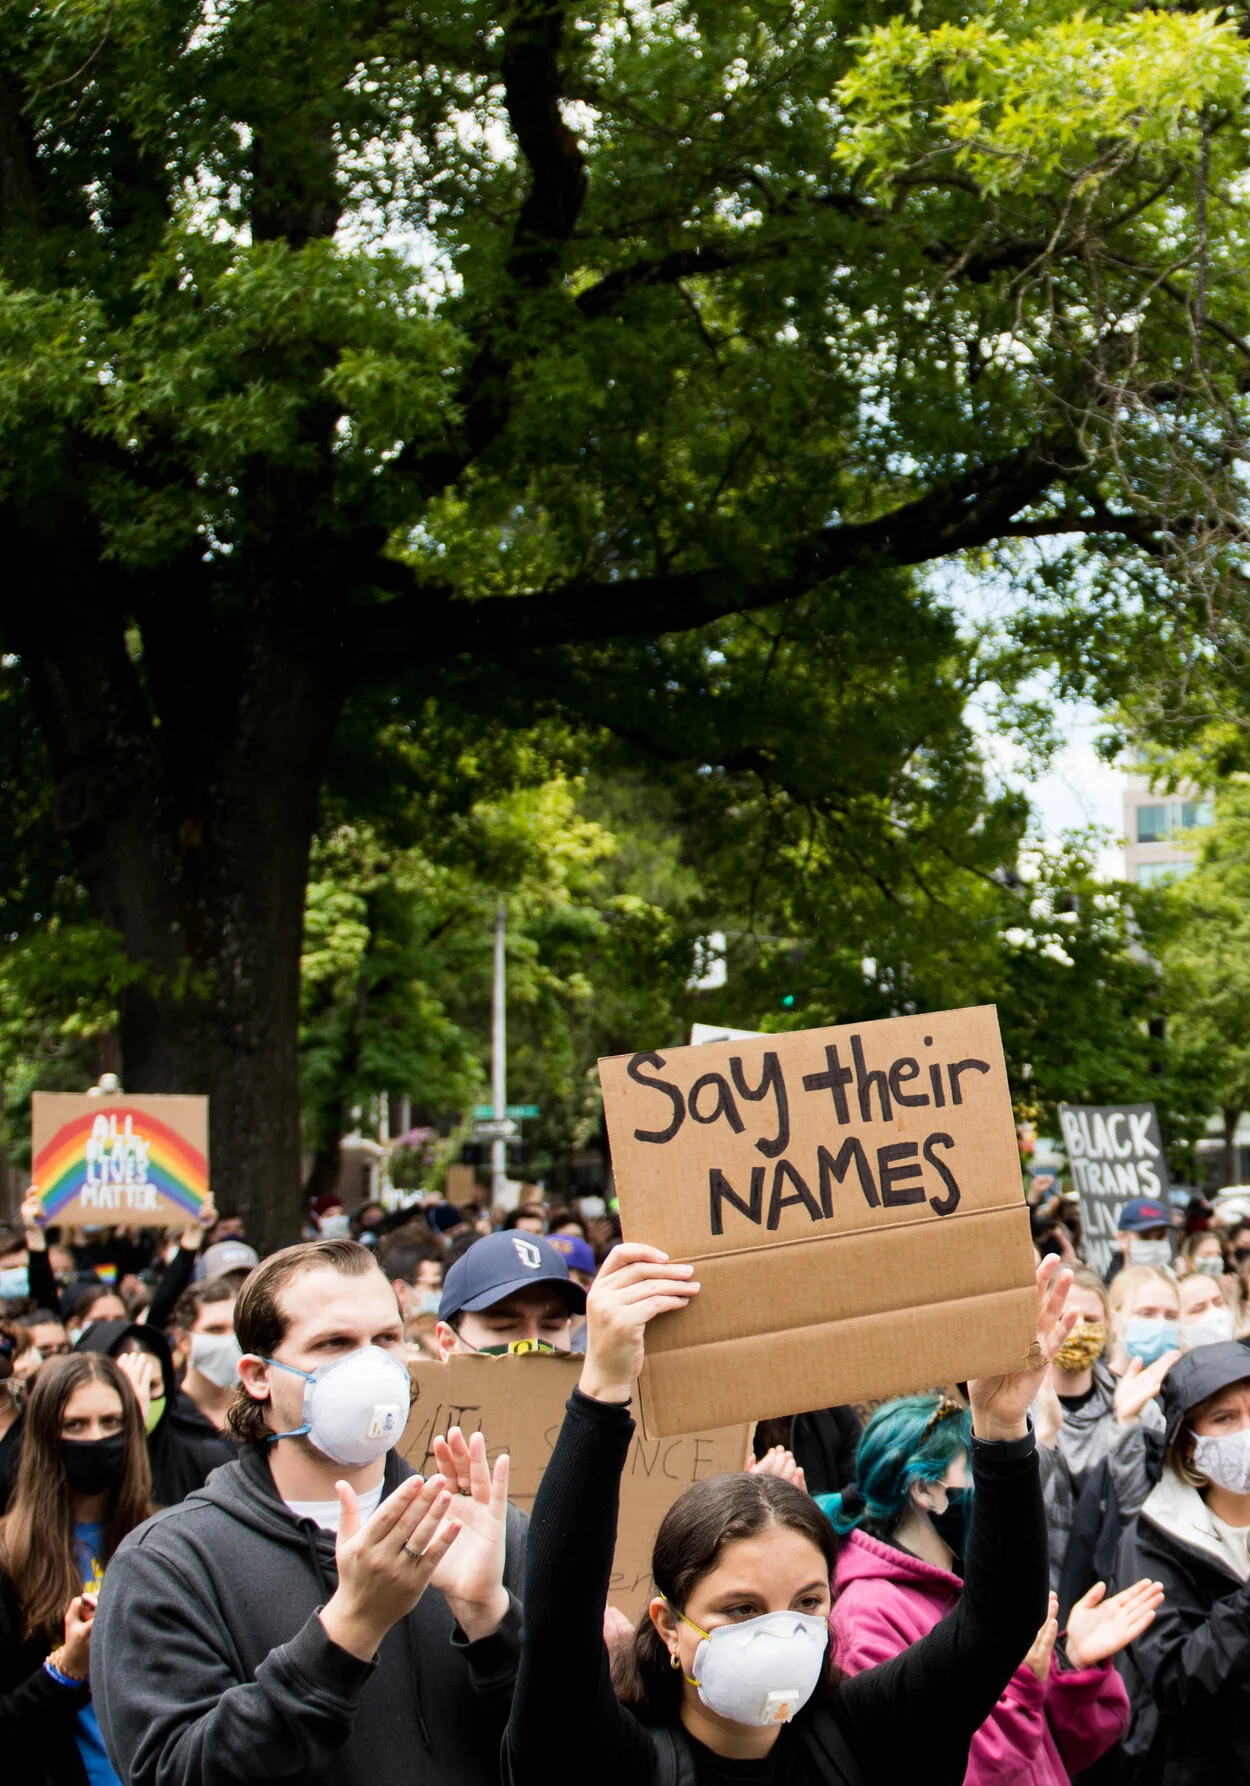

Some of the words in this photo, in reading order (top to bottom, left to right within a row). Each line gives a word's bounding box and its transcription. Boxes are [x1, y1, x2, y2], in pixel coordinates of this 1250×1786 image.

[627, 1051, 790, 1158] Say
[802, 1034, 990, 1125] their
[92, 1114, 142, 1140] ALL
[1063, 1110, 1160, 1159] BLACK
[86, 1136, 151, 1164] BLACK
[87, 1157, 149, 1185] LIVES
[709, 1132, 961, 1235] NAMES
[1073, 1158, 1162, 1199] TRANS
[1080, 1199, 1124, 1238] LIV
